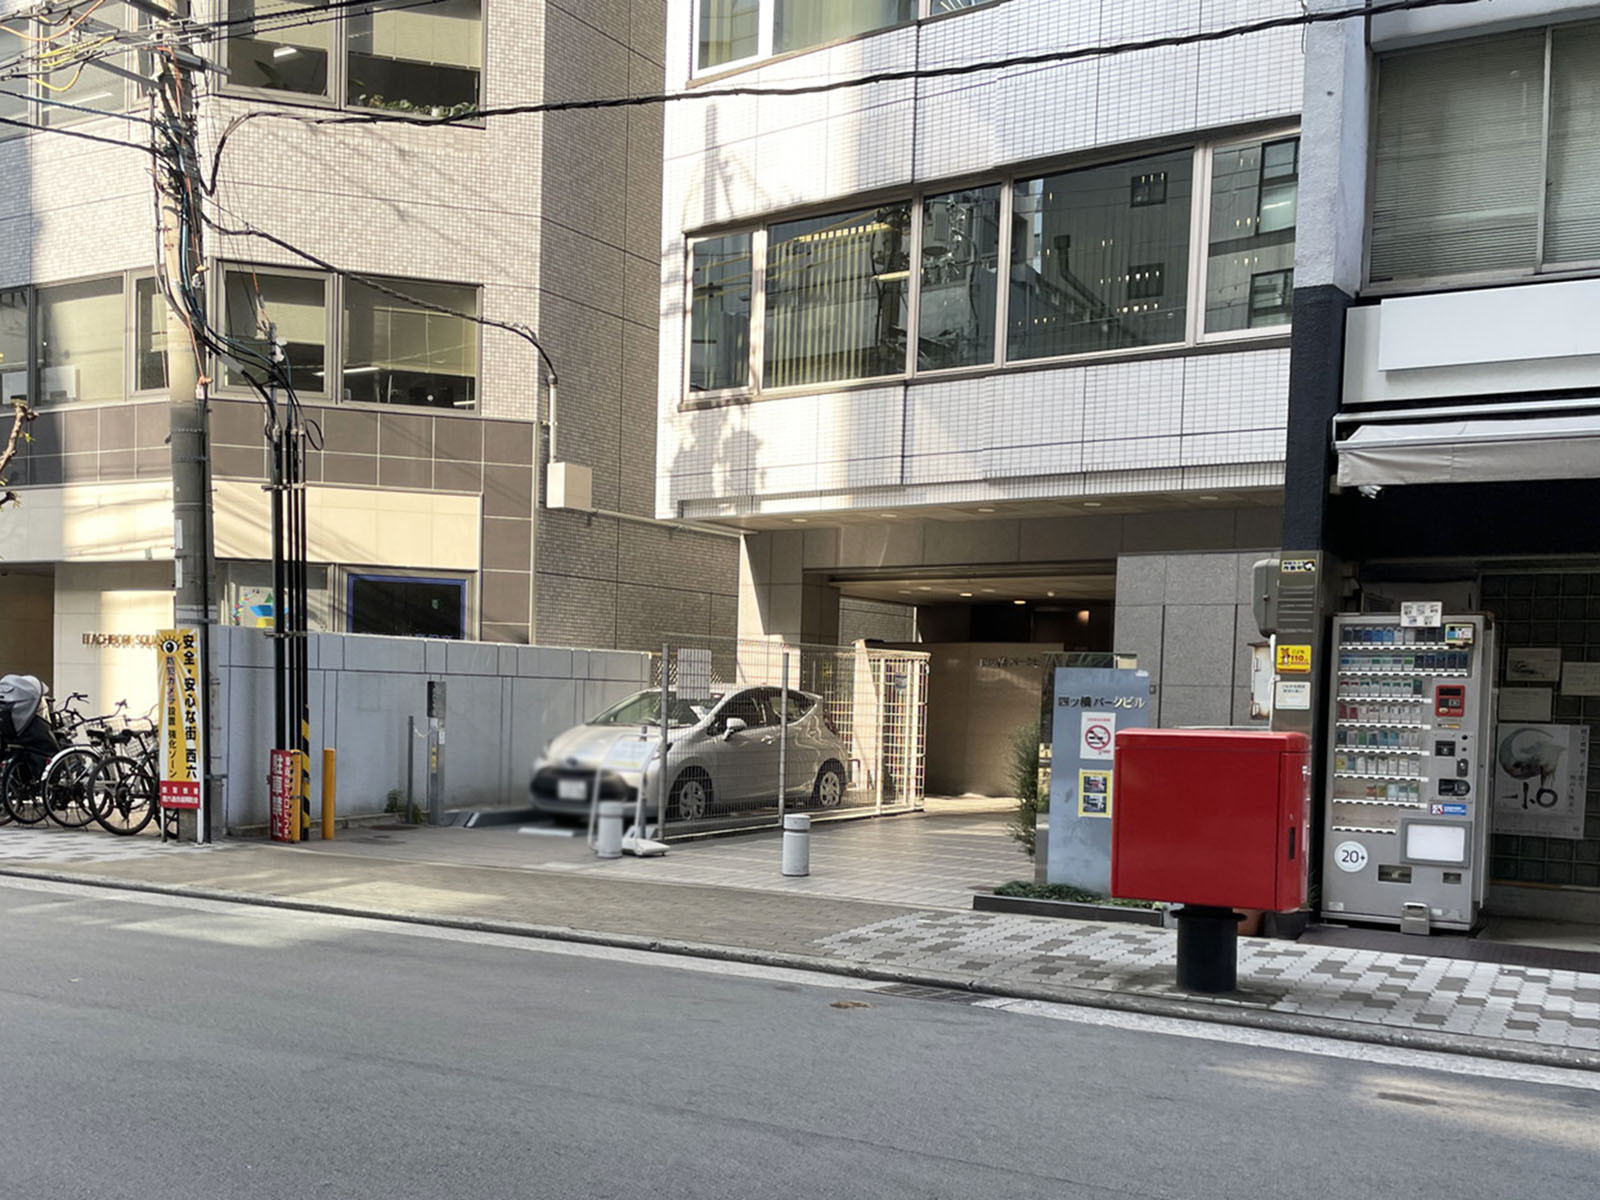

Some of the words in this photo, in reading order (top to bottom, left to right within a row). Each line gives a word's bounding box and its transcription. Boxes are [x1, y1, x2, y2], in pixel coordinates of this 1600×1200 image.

[183, 634, 197, 741] 安全・安心な街
[185, 748, 197, 778] 西六
